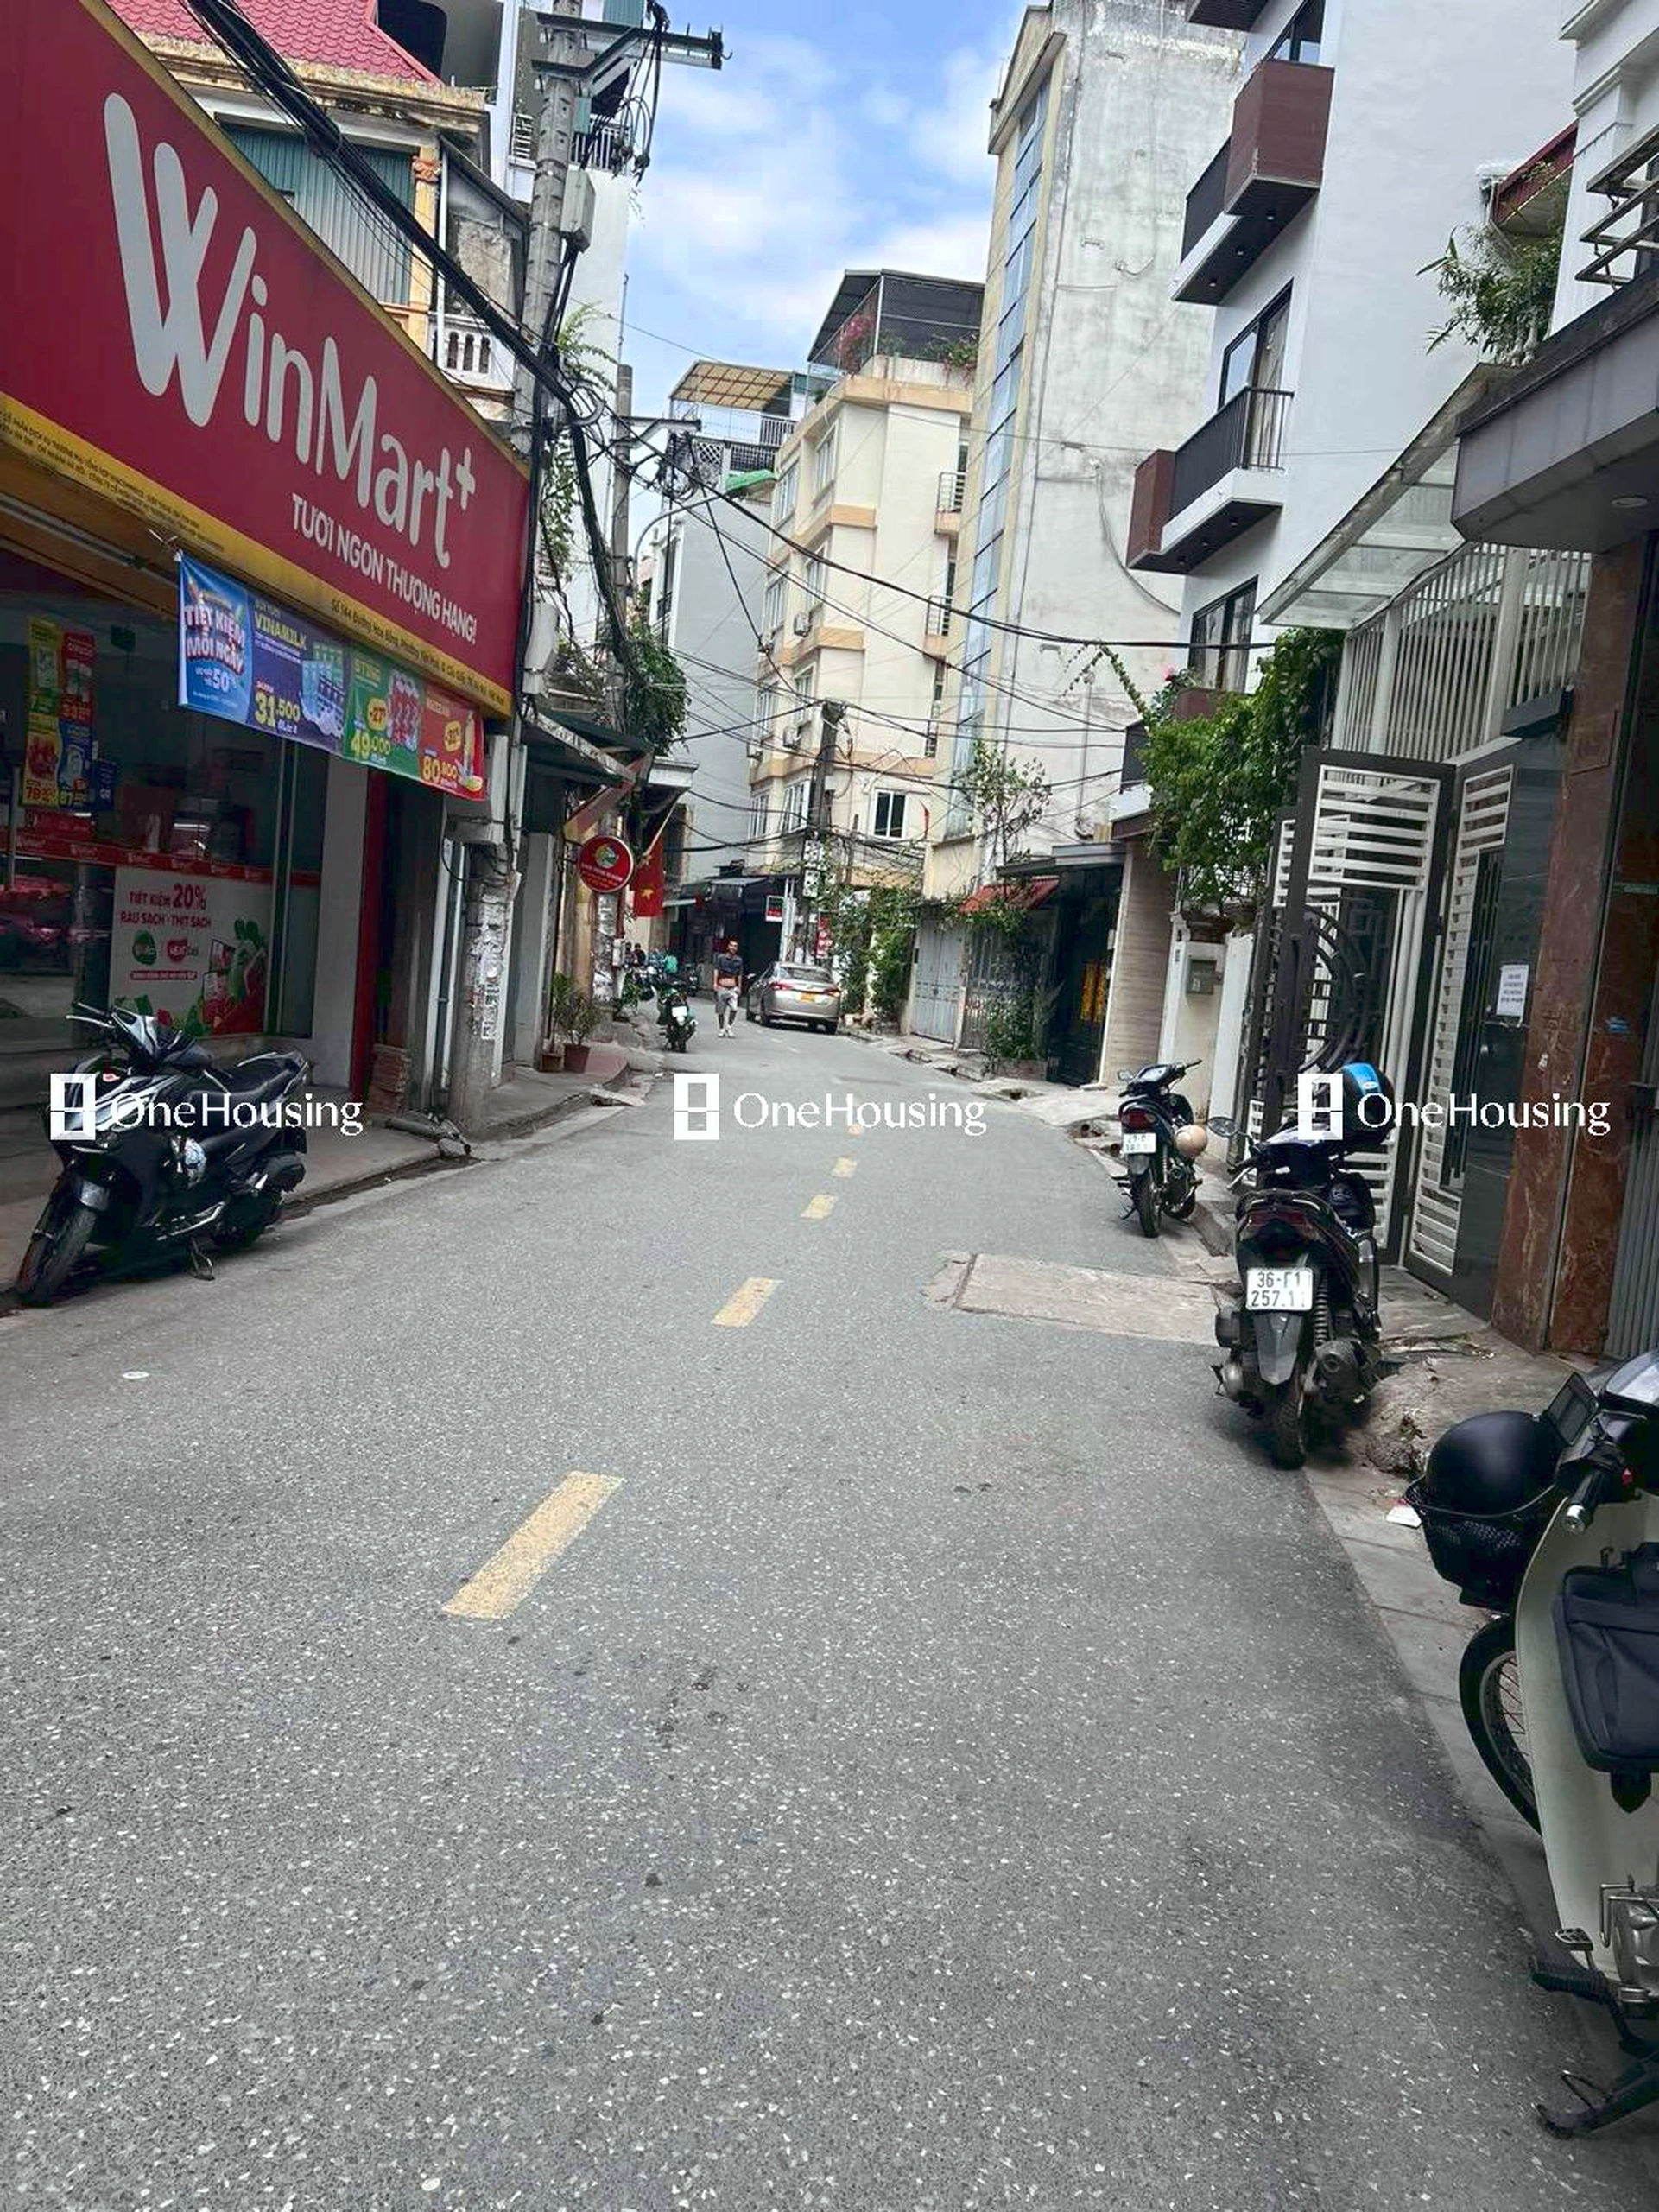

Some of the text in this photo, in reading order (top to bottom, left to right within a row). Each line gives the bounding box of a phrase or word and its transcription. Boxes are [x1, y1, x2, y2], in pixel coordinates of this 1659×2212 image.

[337, 525, 383, 584] NGON
[441, 598, 477, 645] HẠNG!
[173, 883, 207, 910] 20%
[1251, 1290, 1306, 1308] 257.1
